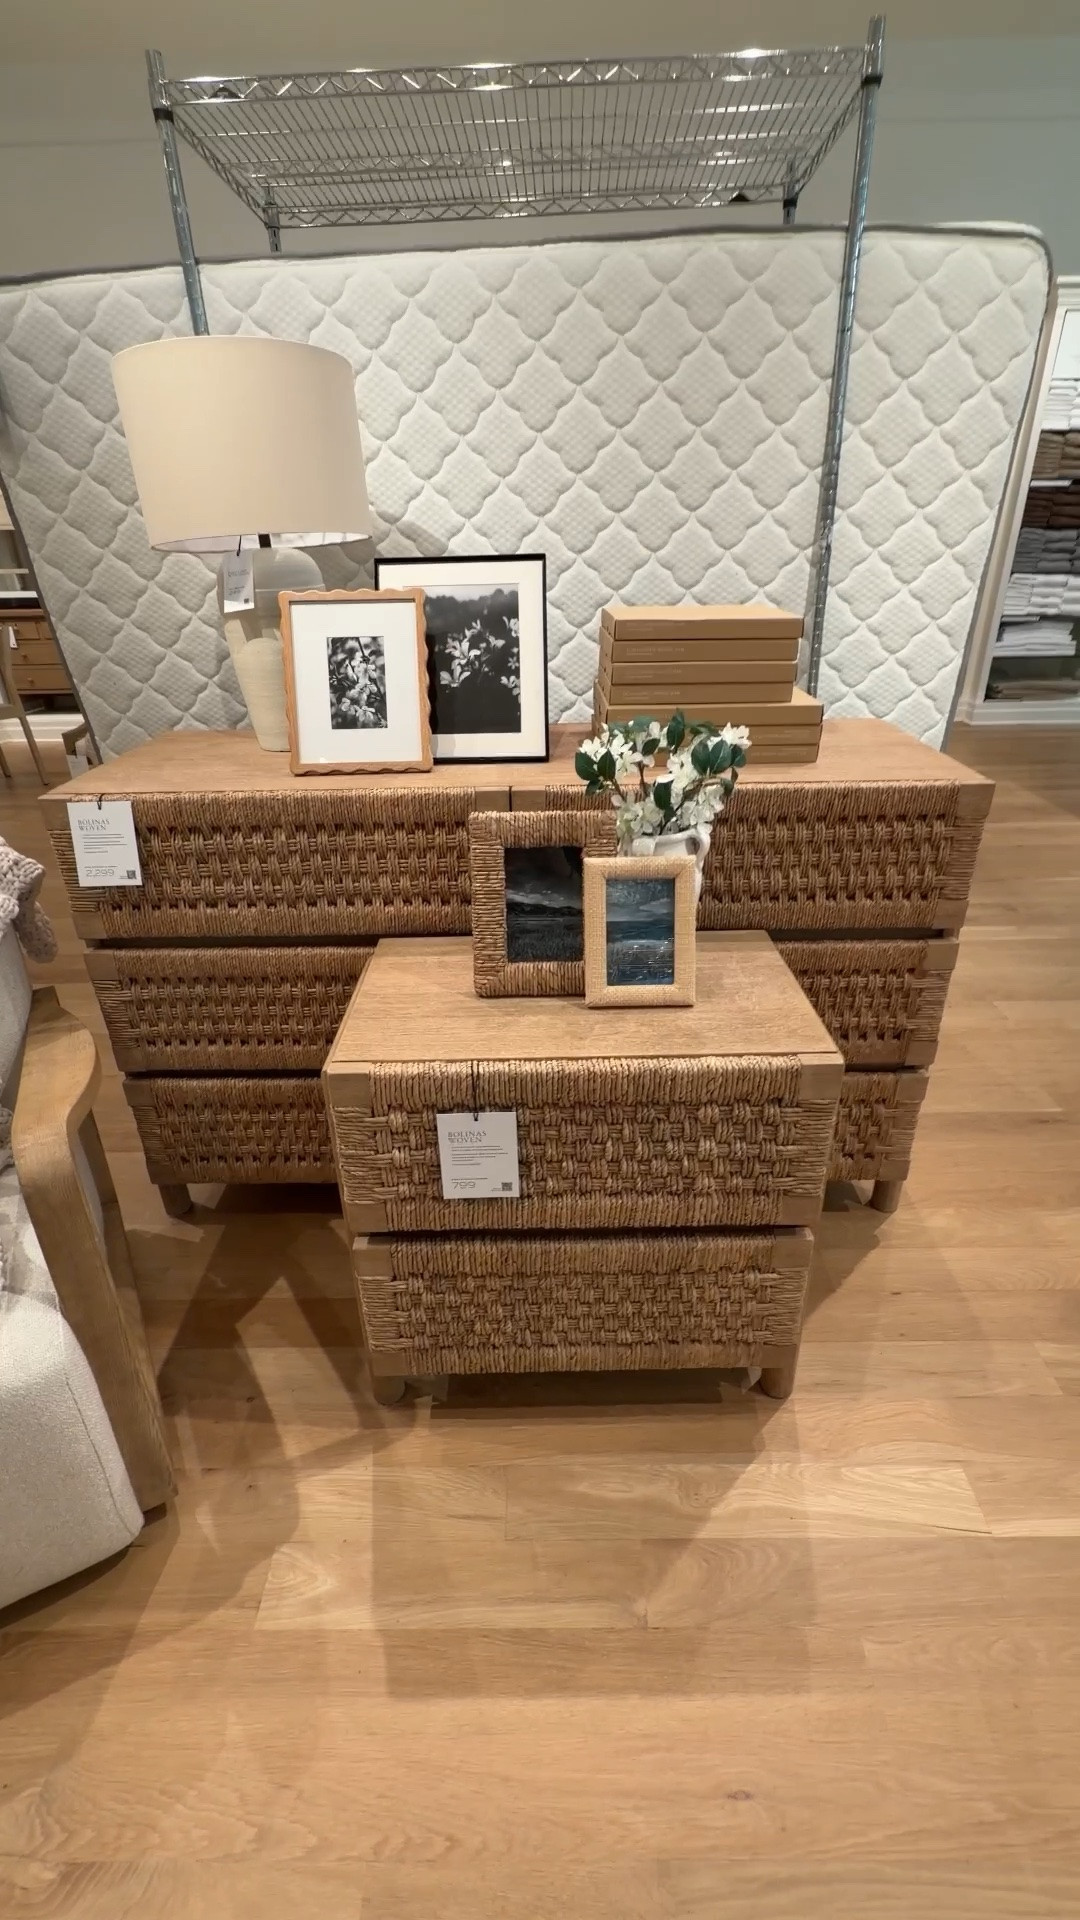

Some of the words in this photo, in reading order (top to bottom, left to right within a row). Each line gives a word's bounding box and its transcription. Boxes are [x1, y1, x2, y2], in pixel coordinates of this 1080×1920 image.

[77, 818, 110, 826] BOLINAS
[447, 1130, 487, 1138] BOLINAS
[451, 1181, 476, 1189] 799
